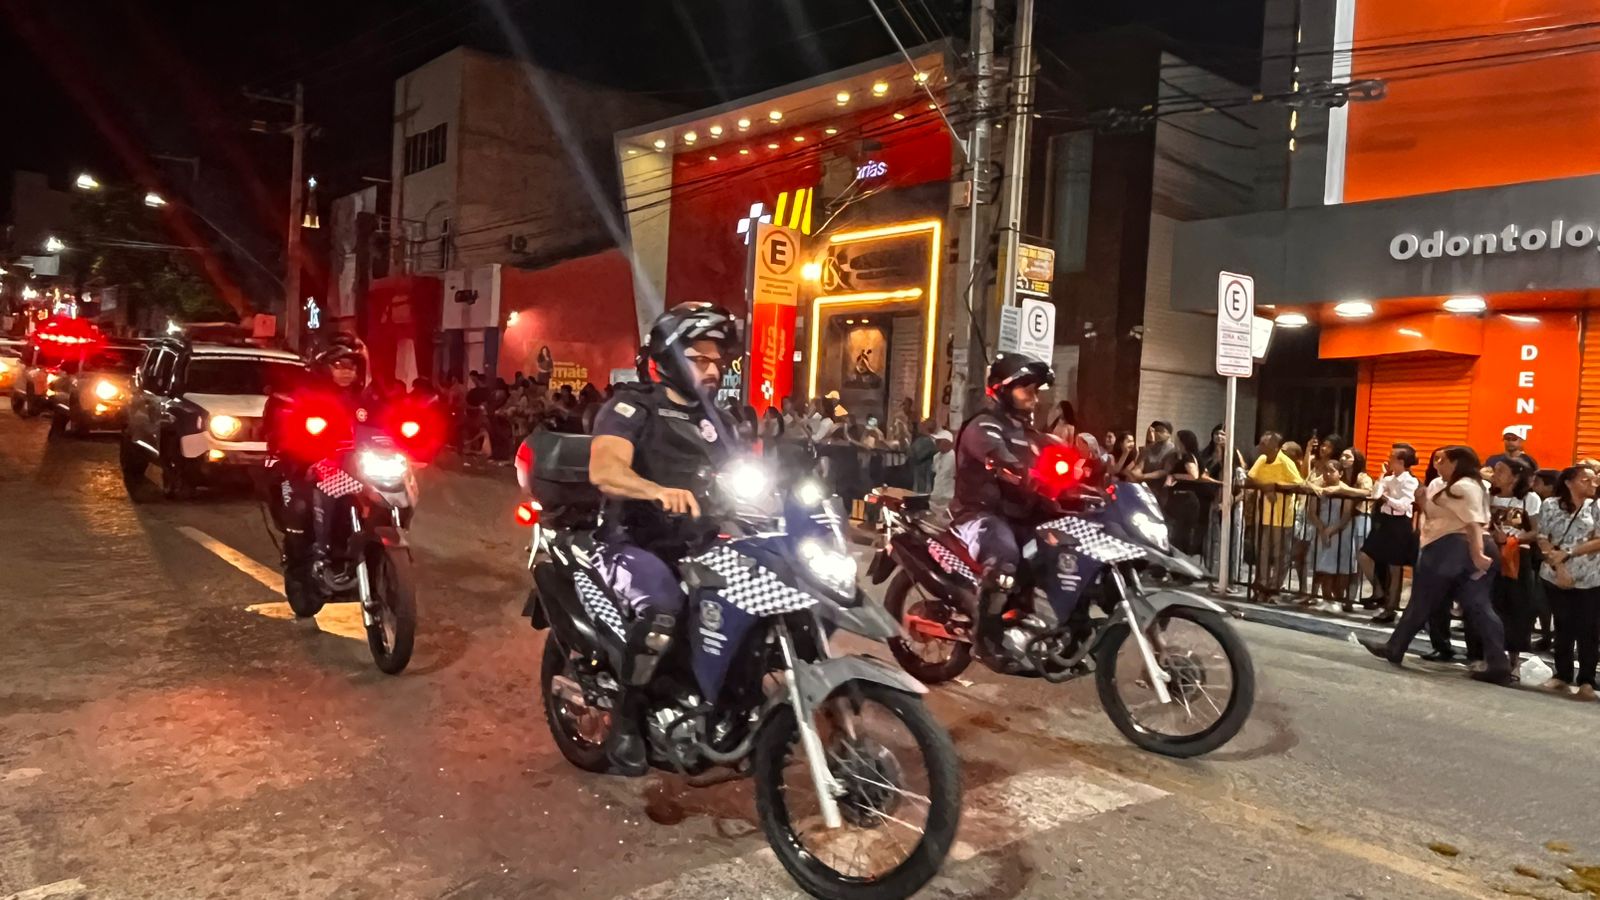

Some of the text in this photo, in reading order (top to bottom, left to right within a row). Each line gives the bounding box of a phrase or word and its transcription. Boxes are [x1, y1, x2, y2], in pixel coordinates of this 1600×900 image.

[1389, 219, 1600, 260] Odontolo
[771, 239, 787, 267] E
[1232, 290, 1240, 311] E
[1034, 314, 1042, 332] E
[761, 325, 777, 381] Ultra
[552, 364, 588, 379] mais
